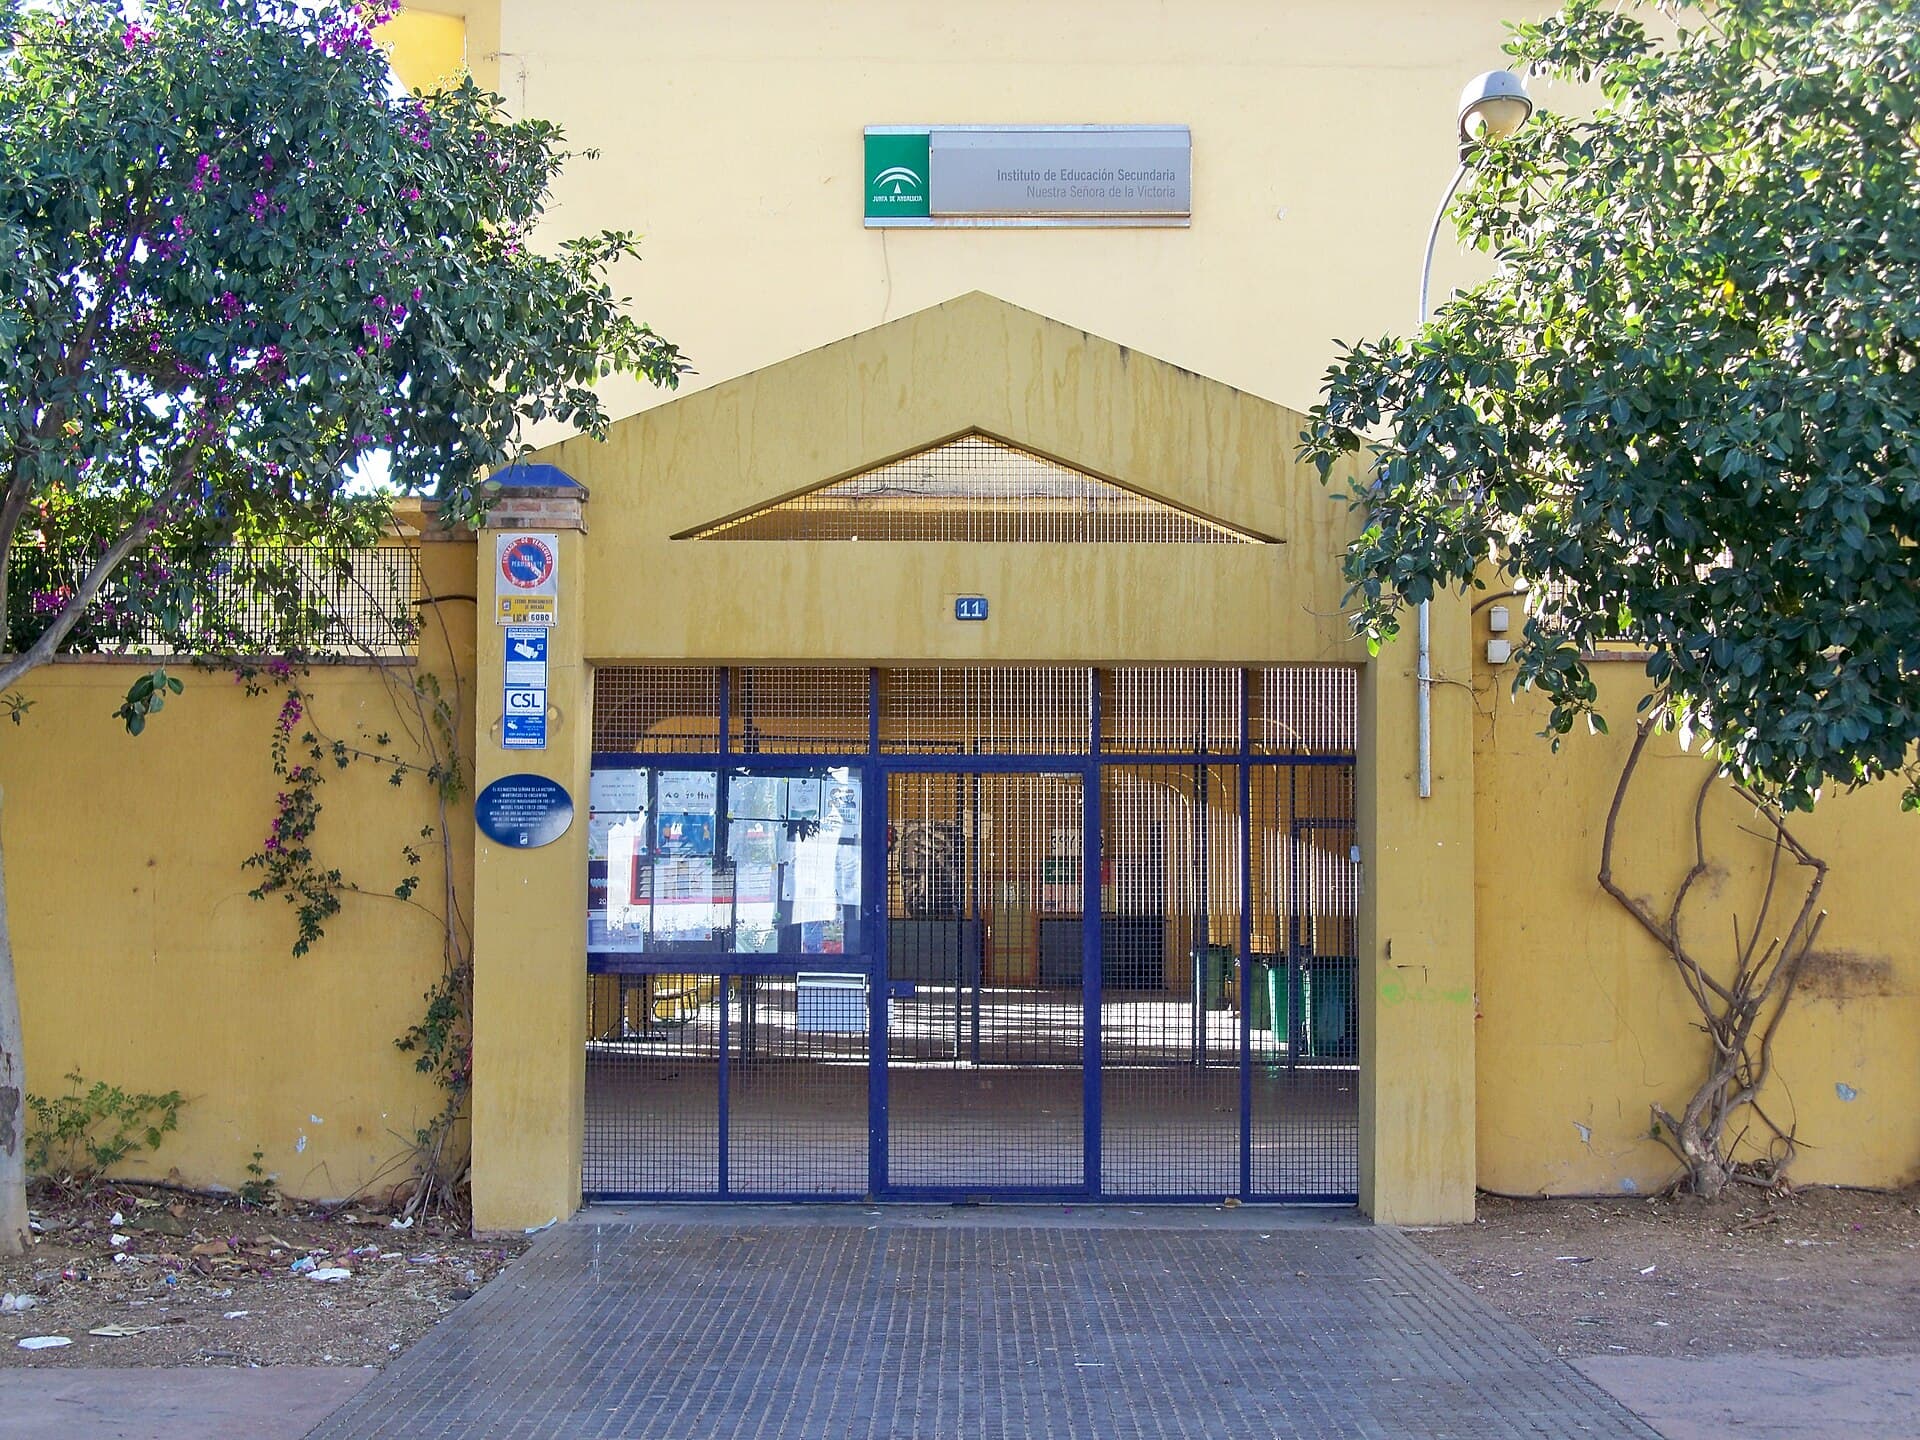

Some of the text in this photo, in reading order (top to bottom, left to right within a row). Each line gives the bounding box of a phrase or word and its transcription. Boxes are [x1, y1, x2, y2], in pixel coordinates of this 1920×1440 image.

[997, 168, 1176, 181] Instituto de Educación Secundaria
[1026, 185, 1176, 198] Nuestra Señora de la Victoria
[960, 600, 982, 617] 11
[510, 693, 540, 708] CSL
